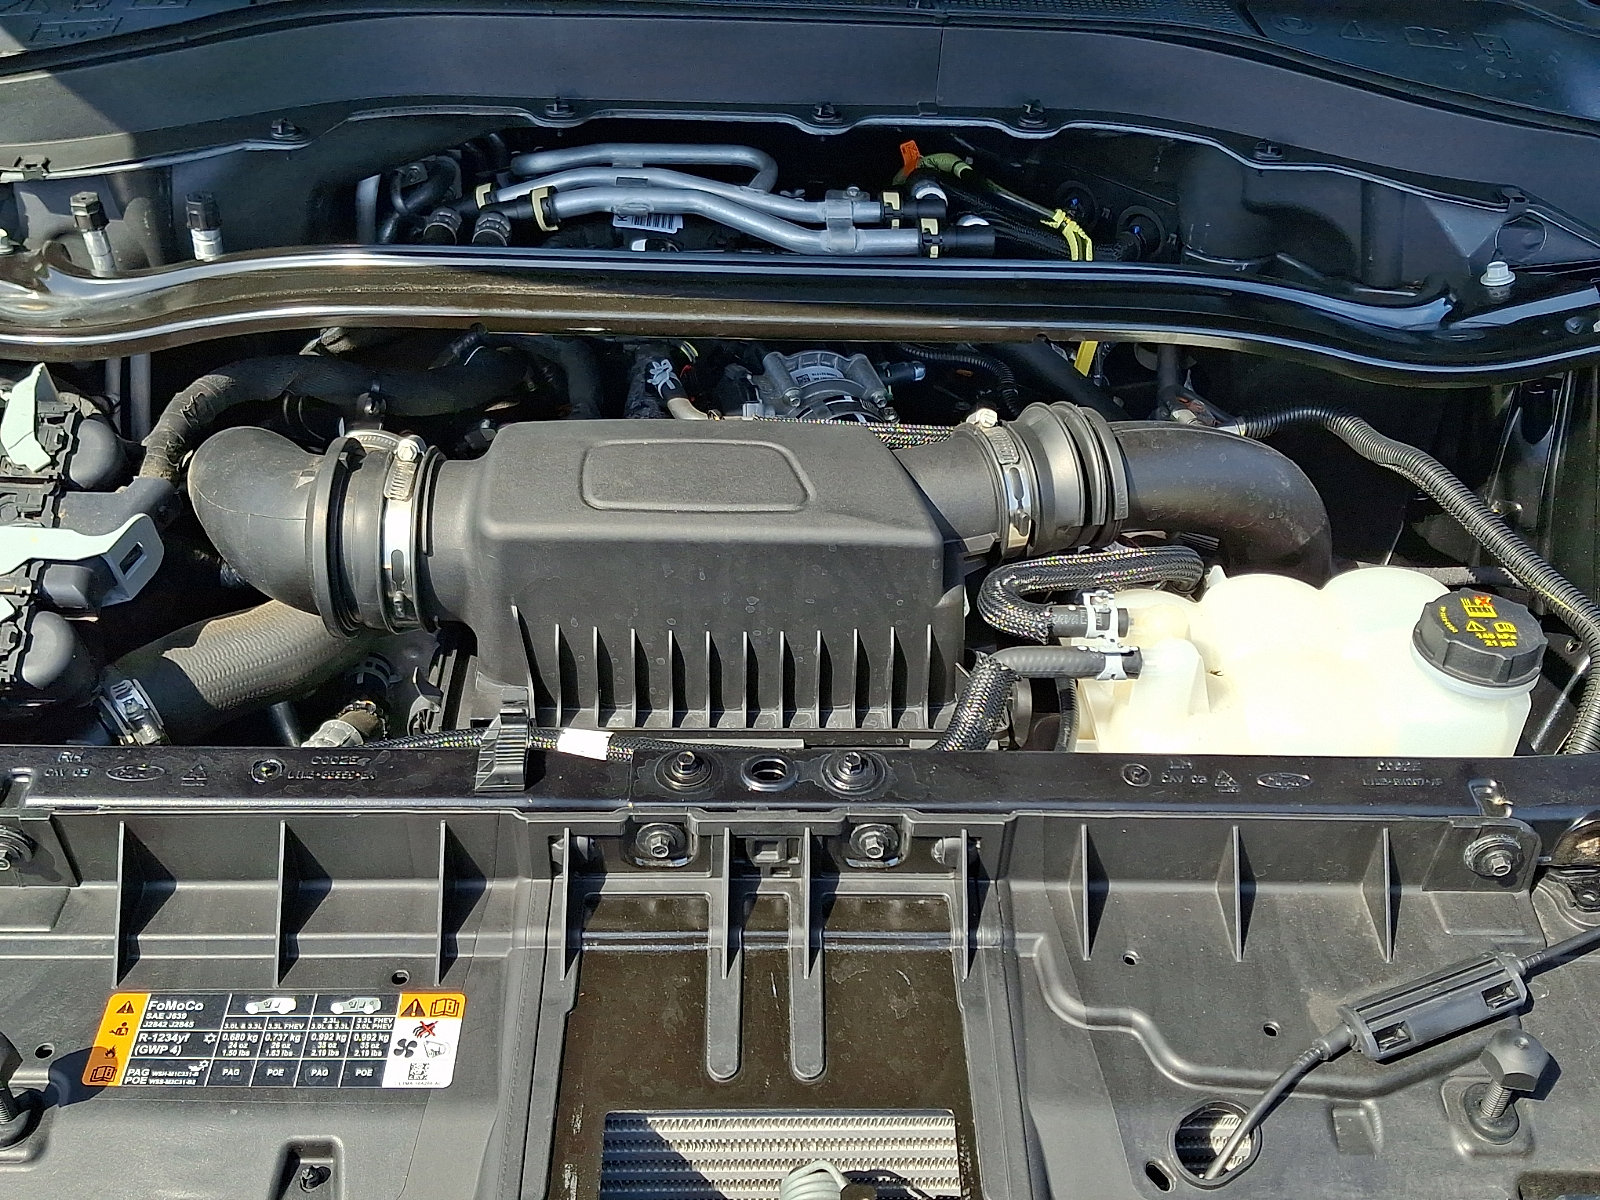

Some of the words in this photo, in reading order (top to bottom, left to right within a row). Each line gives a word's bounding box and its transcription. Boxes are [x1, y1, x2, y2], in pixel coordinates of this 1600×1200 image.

[148, 1001, 204, 1011] FoMoCo
[138, 1033, 191, 1045] R-1234yf
[222, 1033, 246, 1041] 0.680
[247, 1033, 259, 1043] kg
[265, 1033, 289, 1041] 0.737
[290, 1033, 301, 1043] kg
[311, 1033, 334, 1041] 0.992
[335, 1033, 347, 1043] kg
[354, 1033, 377, 1041] 0.992
[378, 1033, 389, 1043] kg
[134, 1045, 168, 1056] (GWP
[170, 1045, 182, 1056] 4)
[127, 1068, 150, 1076] PAG
[222, 1068, 240, 1076] PAG
[267, 1068, 285, 1076] POE
[311, 1068, 329, 1076] PAG
[355, 1068, 373, 1076] POE
[124, 1077, 148, 1085] POE
